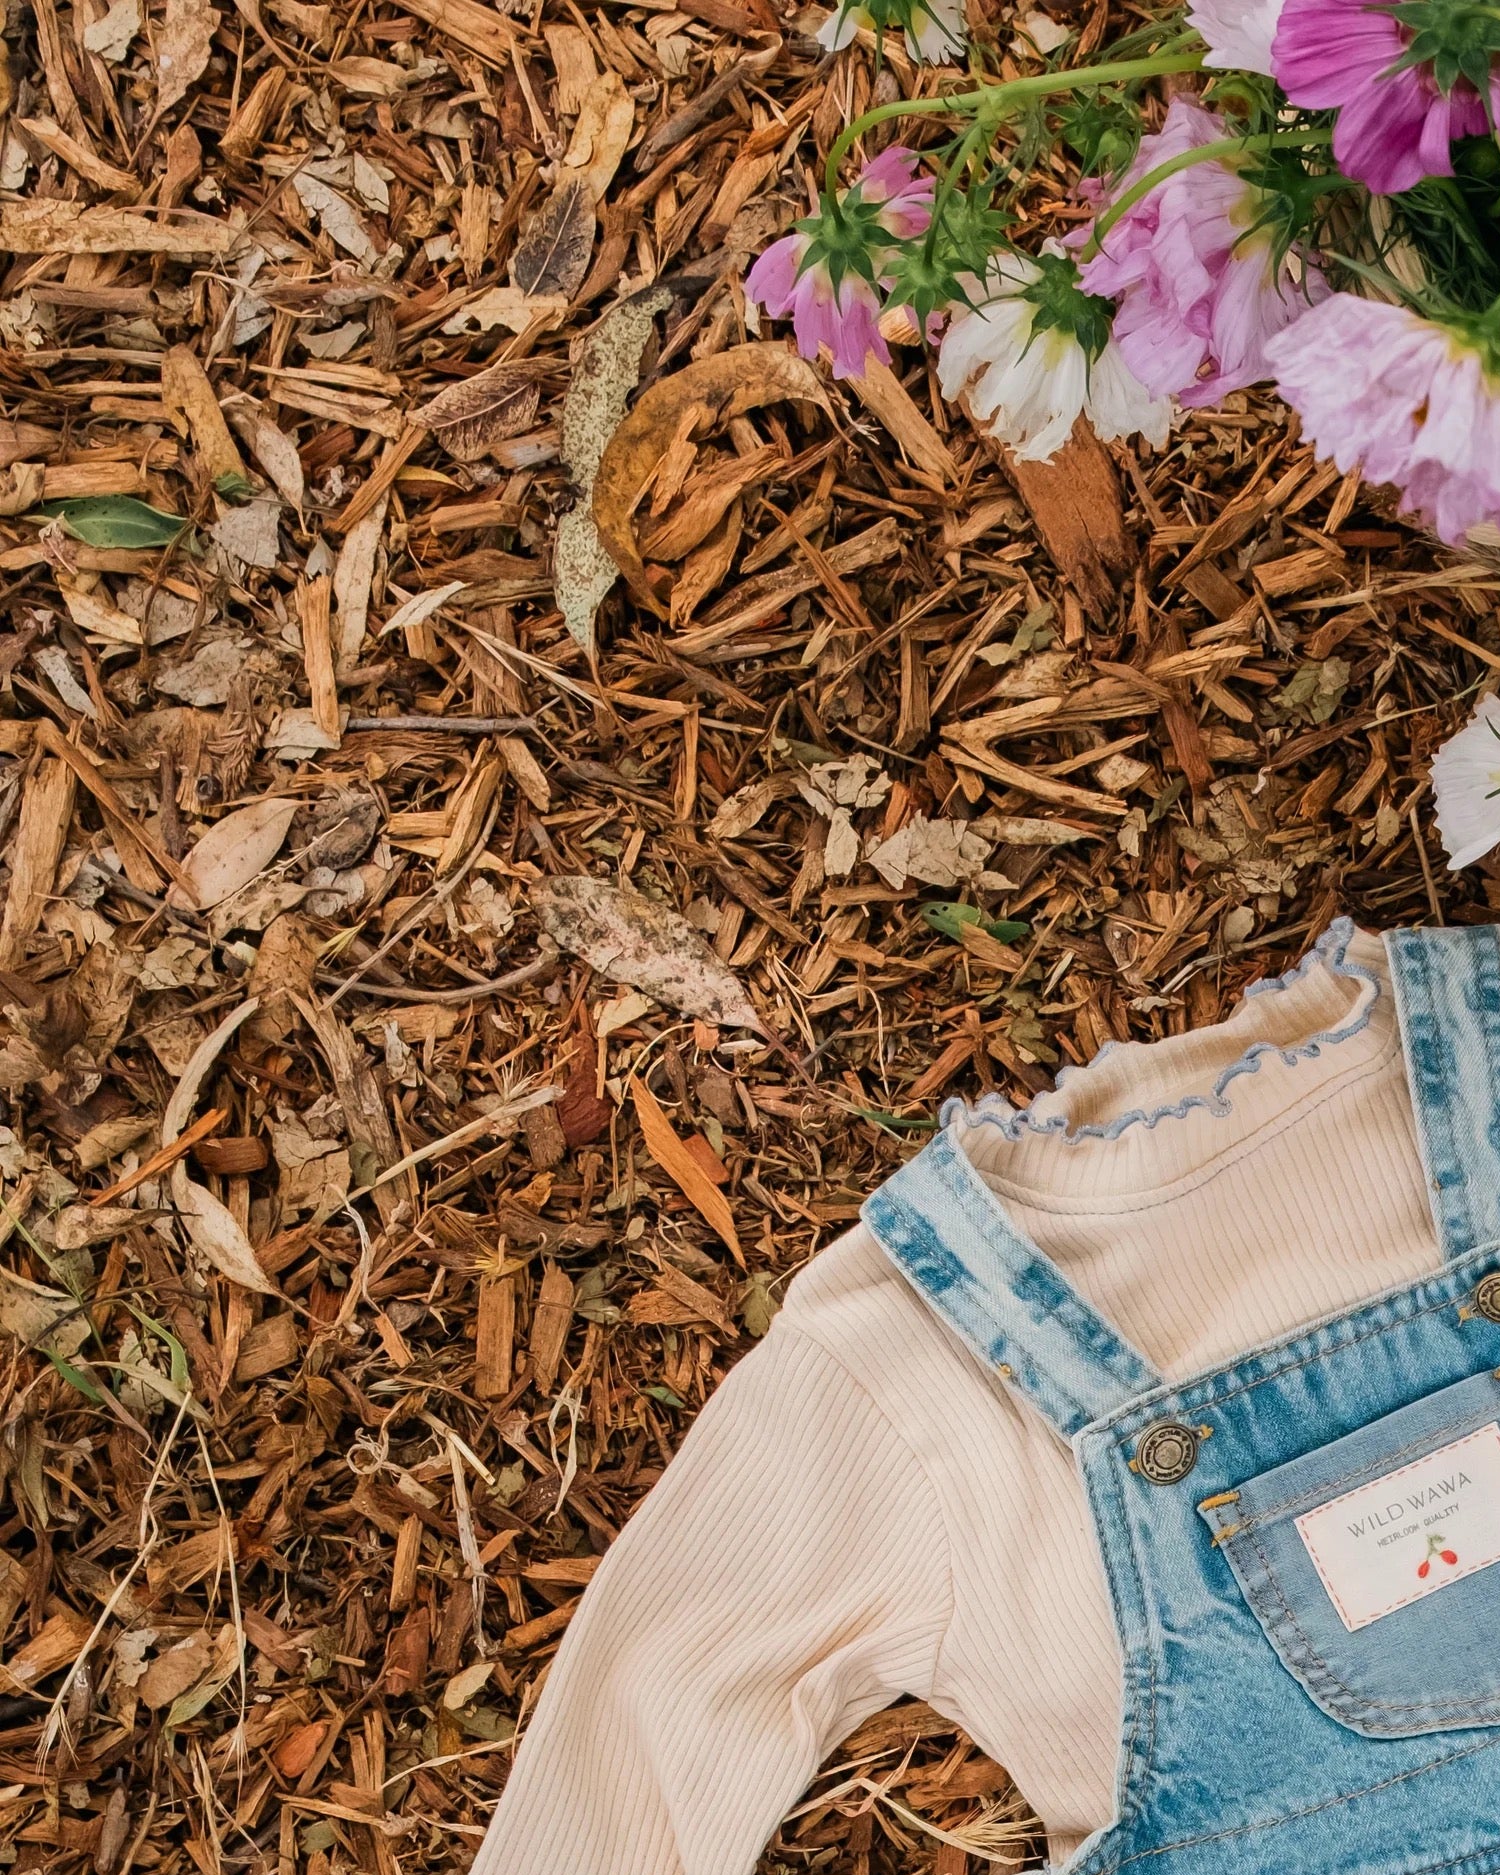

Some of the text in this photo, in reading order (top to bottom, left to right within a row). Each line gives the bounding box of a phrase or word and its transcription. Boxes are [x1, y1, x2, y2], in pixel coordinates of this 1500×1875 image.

[1347, 1471, 1472, 1538] WILD WAWA
[1377, 1502, 1460, 1548] HEIRLOOM QUALITY
